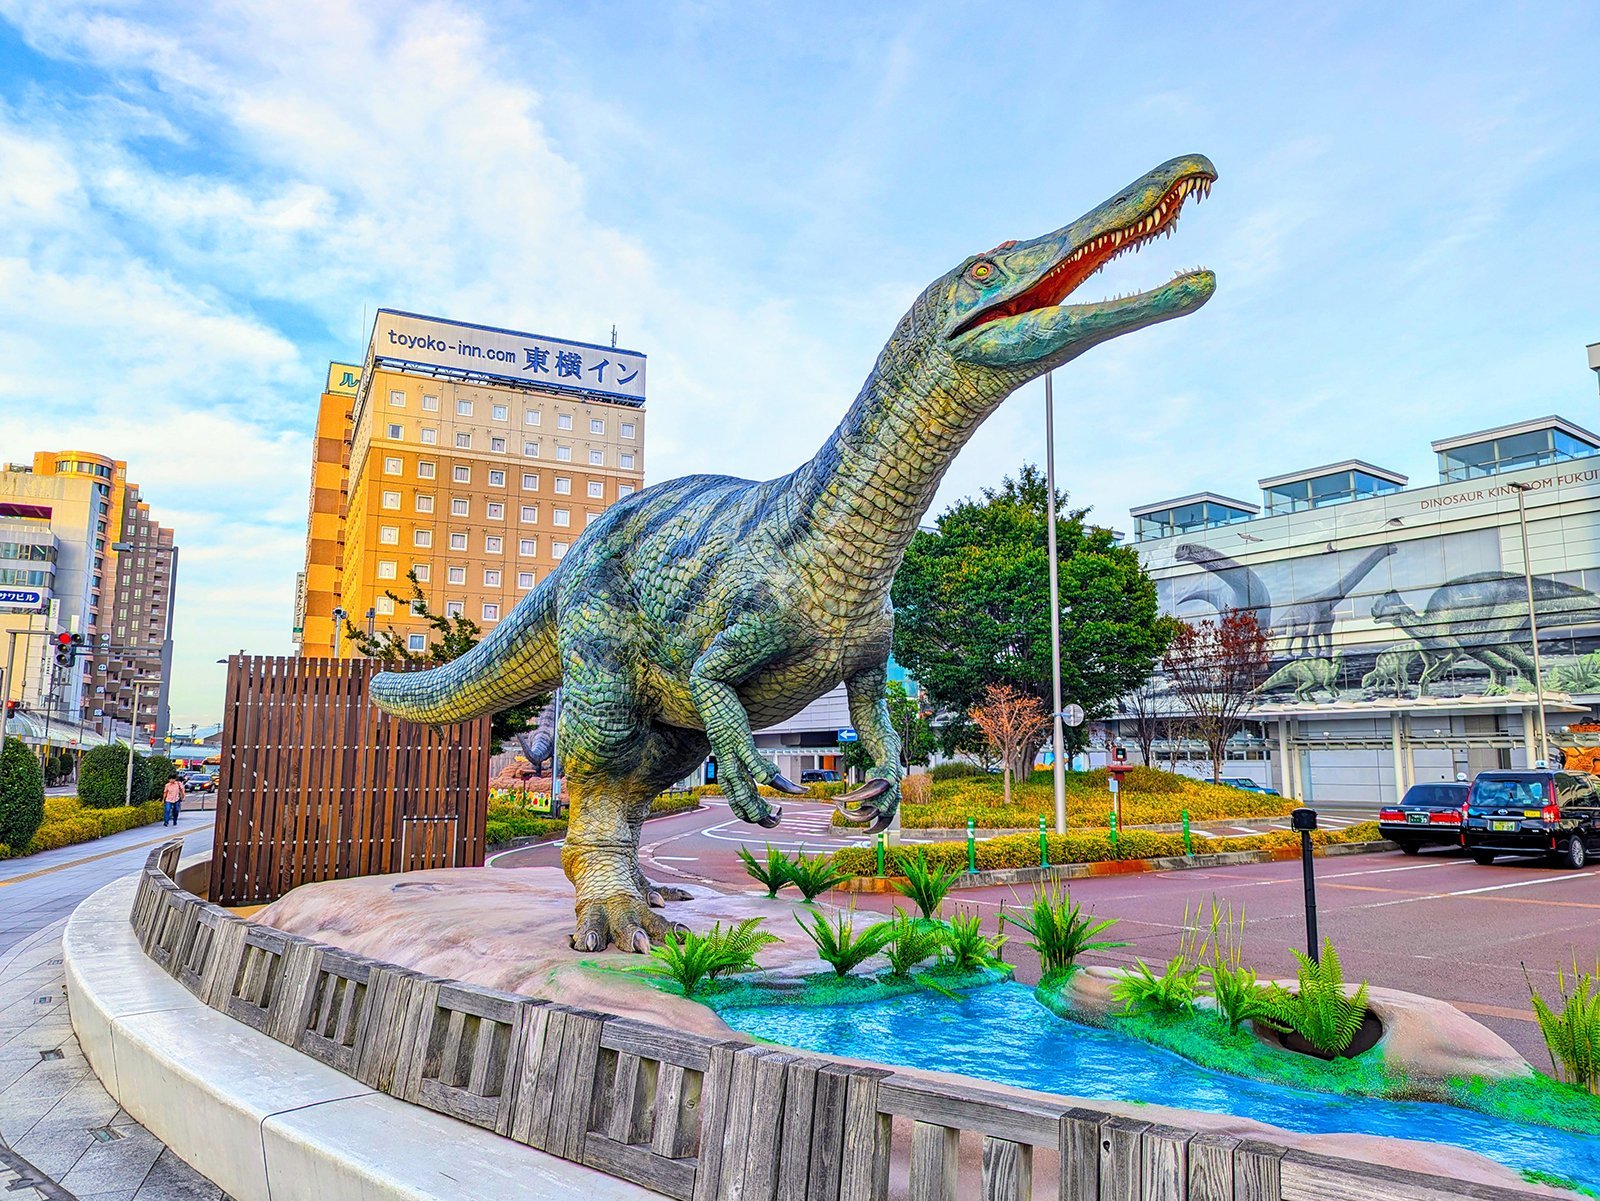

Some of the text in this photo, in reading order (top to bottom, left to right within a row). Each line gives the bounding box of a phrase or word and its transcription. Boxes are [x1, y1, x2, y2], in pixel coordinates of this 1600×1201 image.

[387, 328, 639, 385] toyoko-inn.com 東横イン
[1420, 490, 1484, 510] DINOSAUR
[1557, 469, 1598, 486] FUKUI
